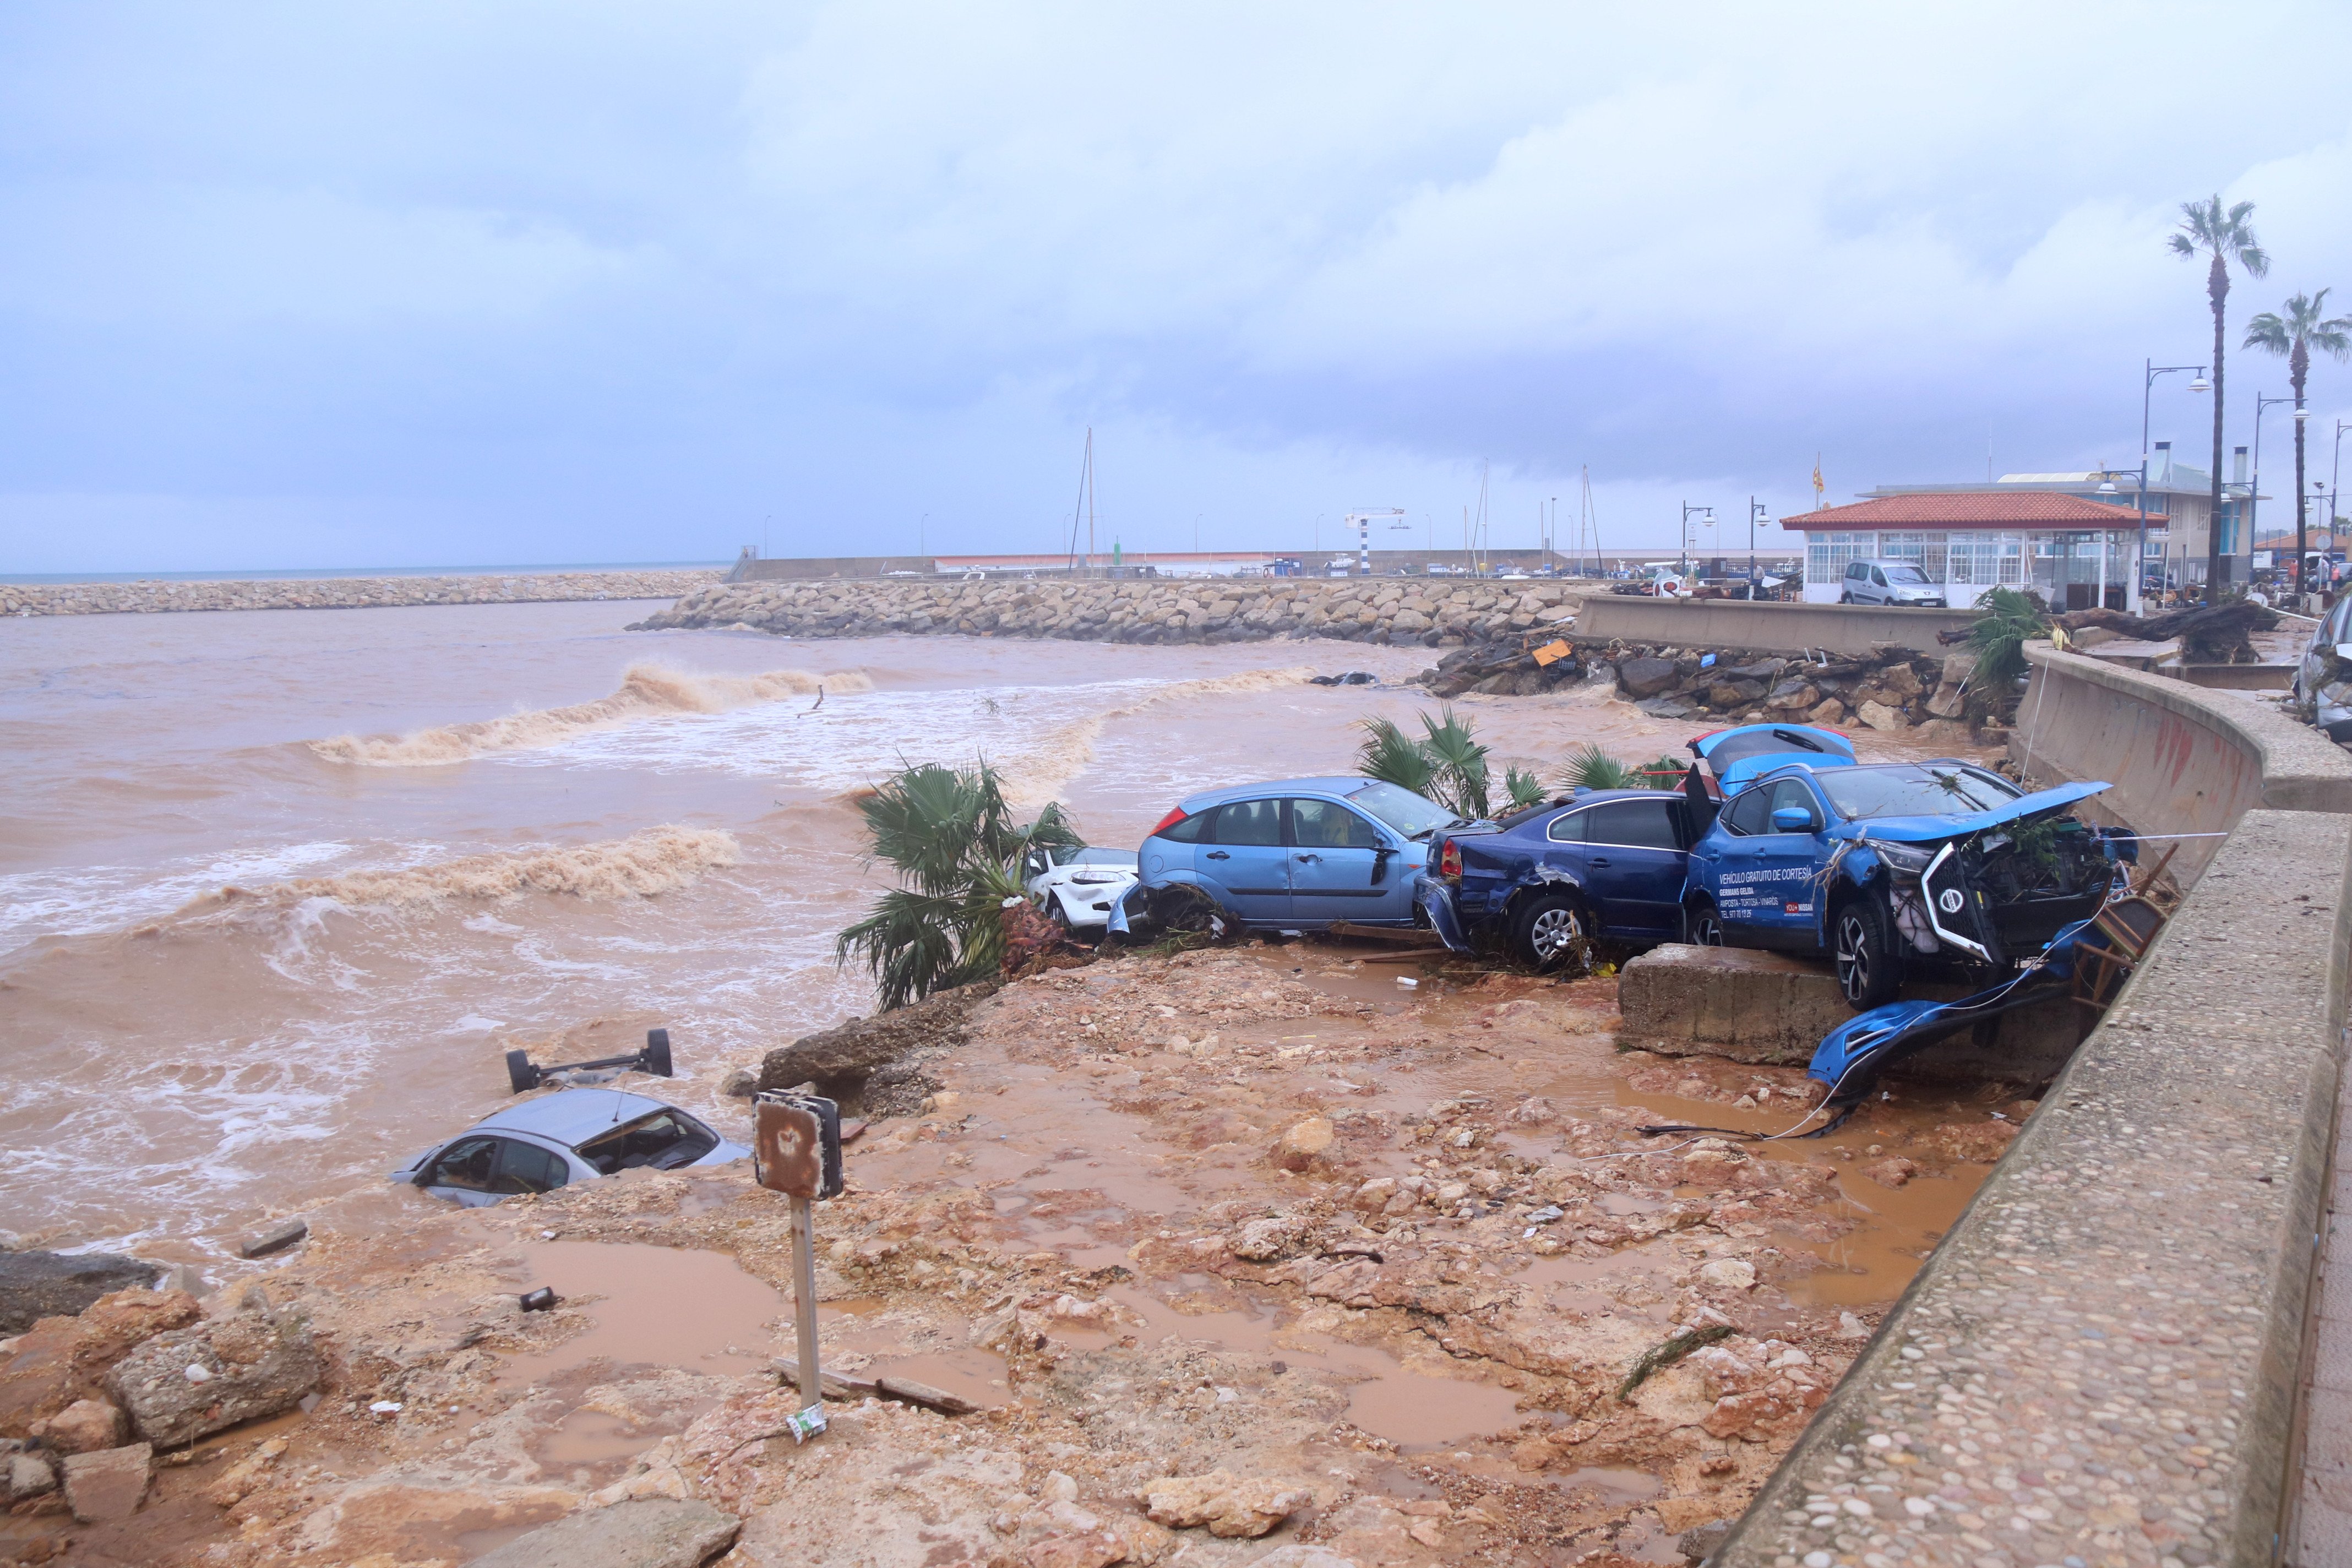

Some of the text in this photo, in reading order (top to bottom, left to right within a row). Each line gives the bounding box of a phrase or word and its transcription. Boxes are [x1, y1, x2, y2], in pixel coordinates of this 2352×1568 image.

[1719, 864, 1812, 884] VEHÍCULO GRATUITO DE CORTESÍA
[1719, 886, 1754, 896] GERMANS GELIDA
[1720, 899, 1739, 907] AMPOSTA
[1741, 898, 1758, 907] TORTOSA
[1946, 891, 1956, 910] NISSAN
